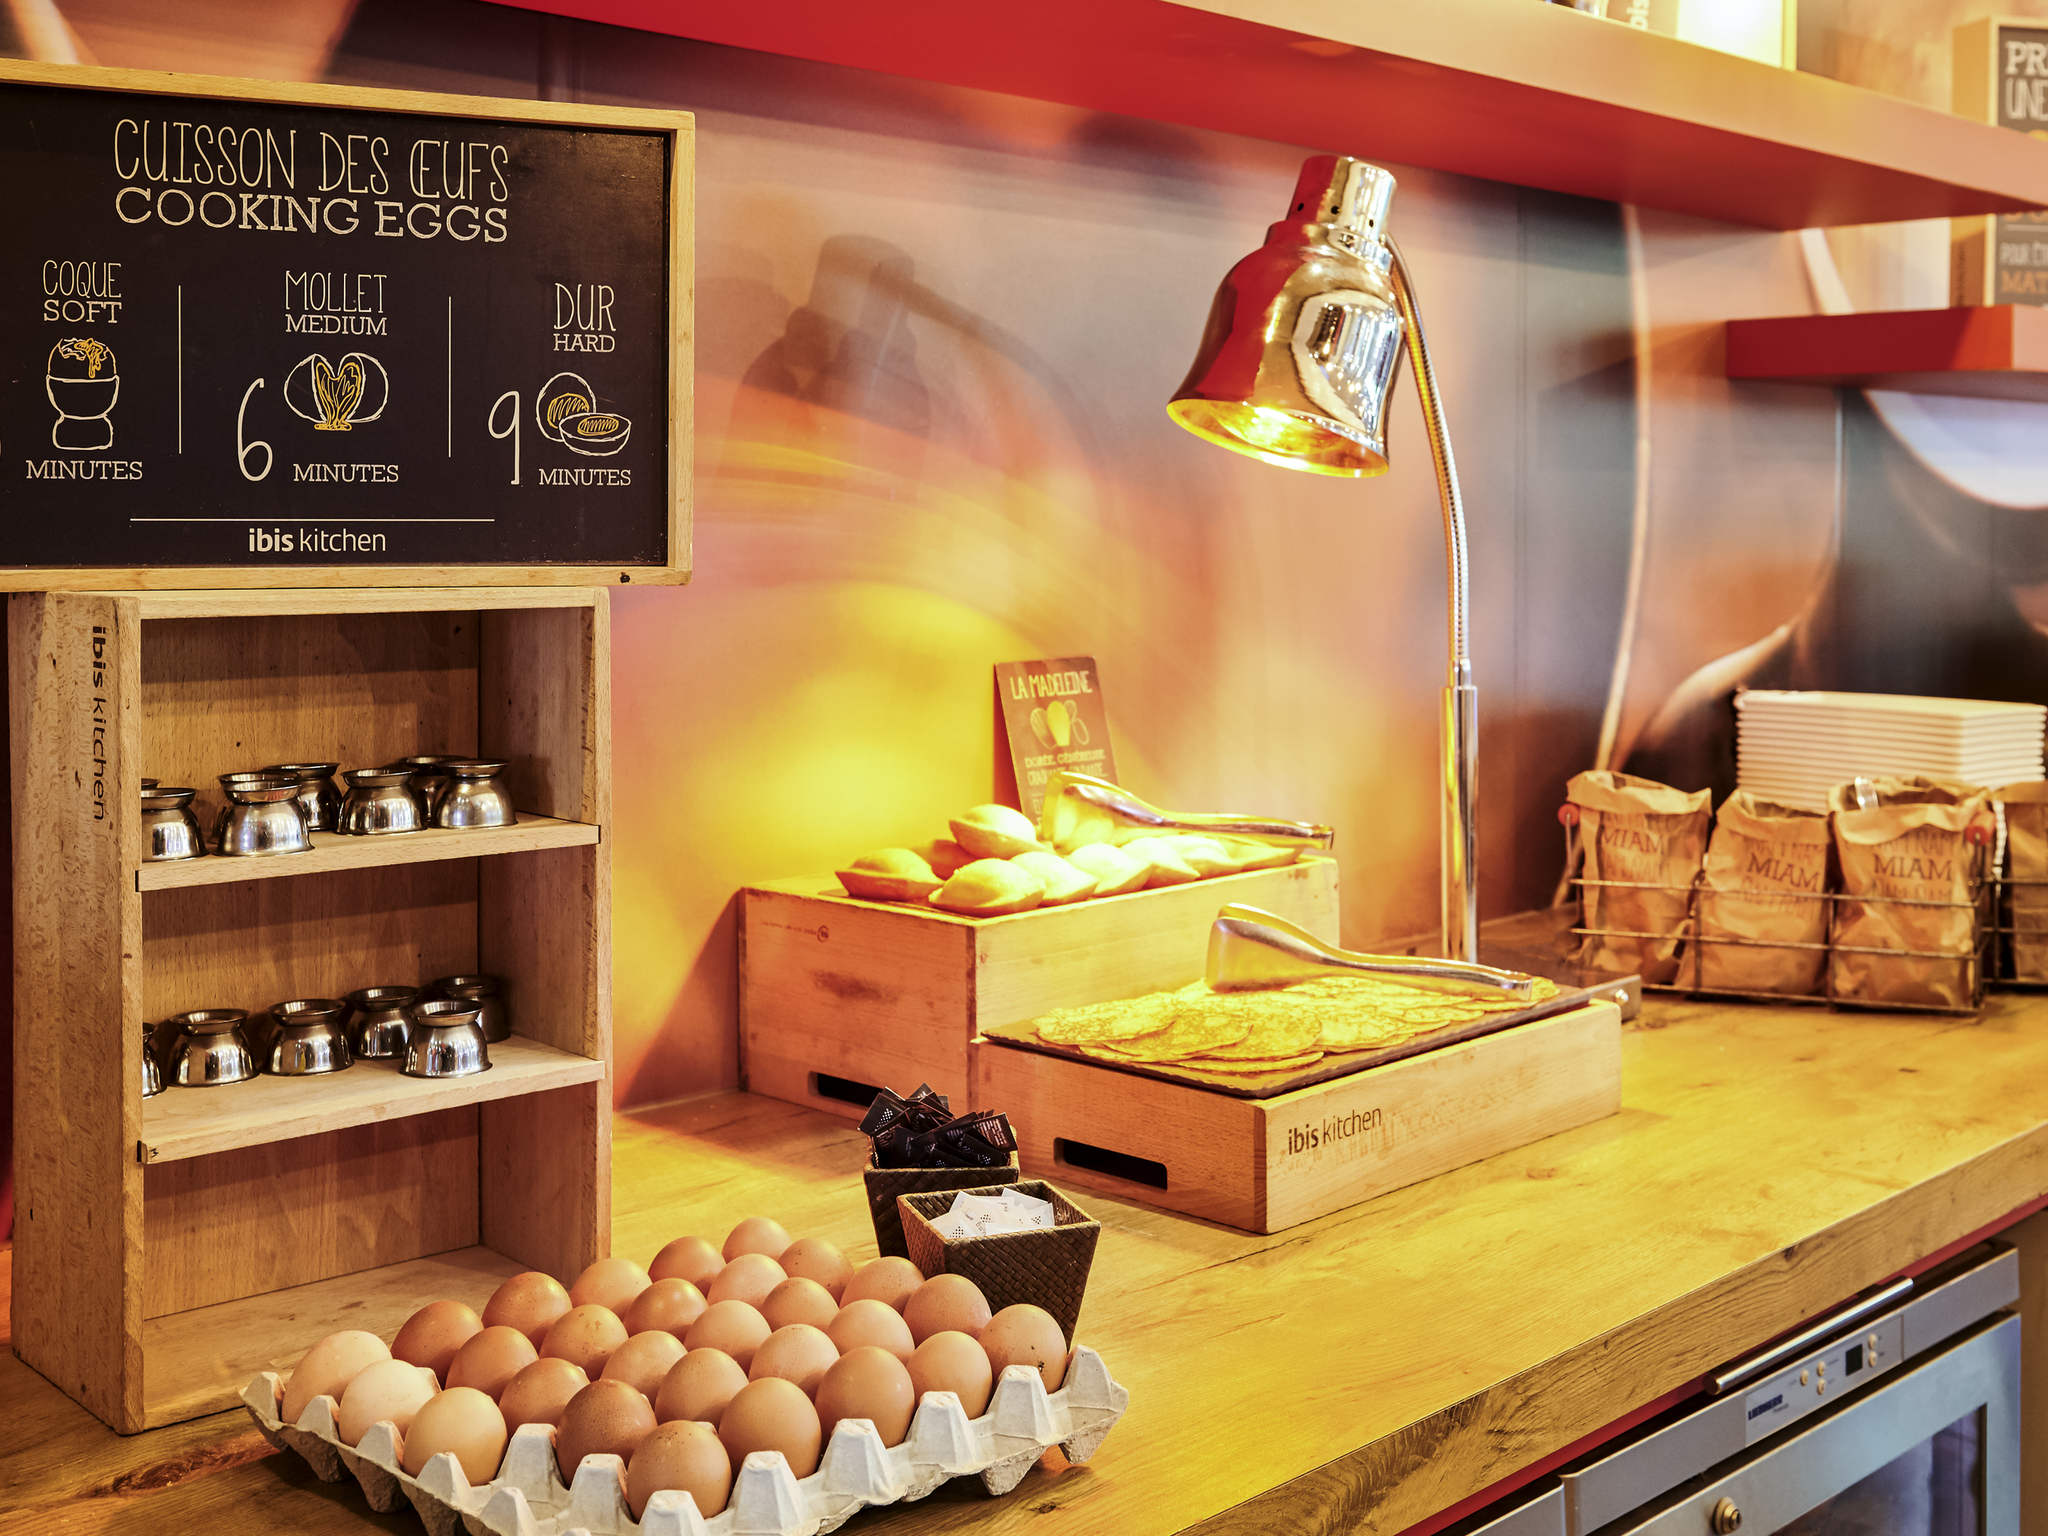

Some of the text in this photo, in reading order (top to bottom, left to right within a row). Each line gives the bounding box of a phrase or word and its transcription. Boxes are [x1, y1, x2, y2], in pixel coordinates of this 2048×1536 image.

[115, 119, 509, 202] CUISSON DES ŒUFS
[115, 186, 508, 243] COOKING EGGS
[43, 260, 122, 298] COQUE
[285, 271, 388, 313] MOLLET
[43, 300, 122, 324] SOFT
[285, 314, 388, 336] MEDIUM
[554, 283, 617, 332] DUR
[553, 333, 616, 353] HARD
[237, 378, 399, 483] 6 MINUTES
[487, 391, 632, 487] 9 MINUTES
[26, 460, 143, 481] MINUTES
[249, 528, 386, 552] ibis kitchen
[1010, 676, 1029, 699] LA
[92, 626, 107, 821] ibis kitchen
[1747, 852, 1819, 892] MIAM
[1872, 852, 1952, 882] MIAM
[1288, 1107, 1383, 1155] ibis kitchen
